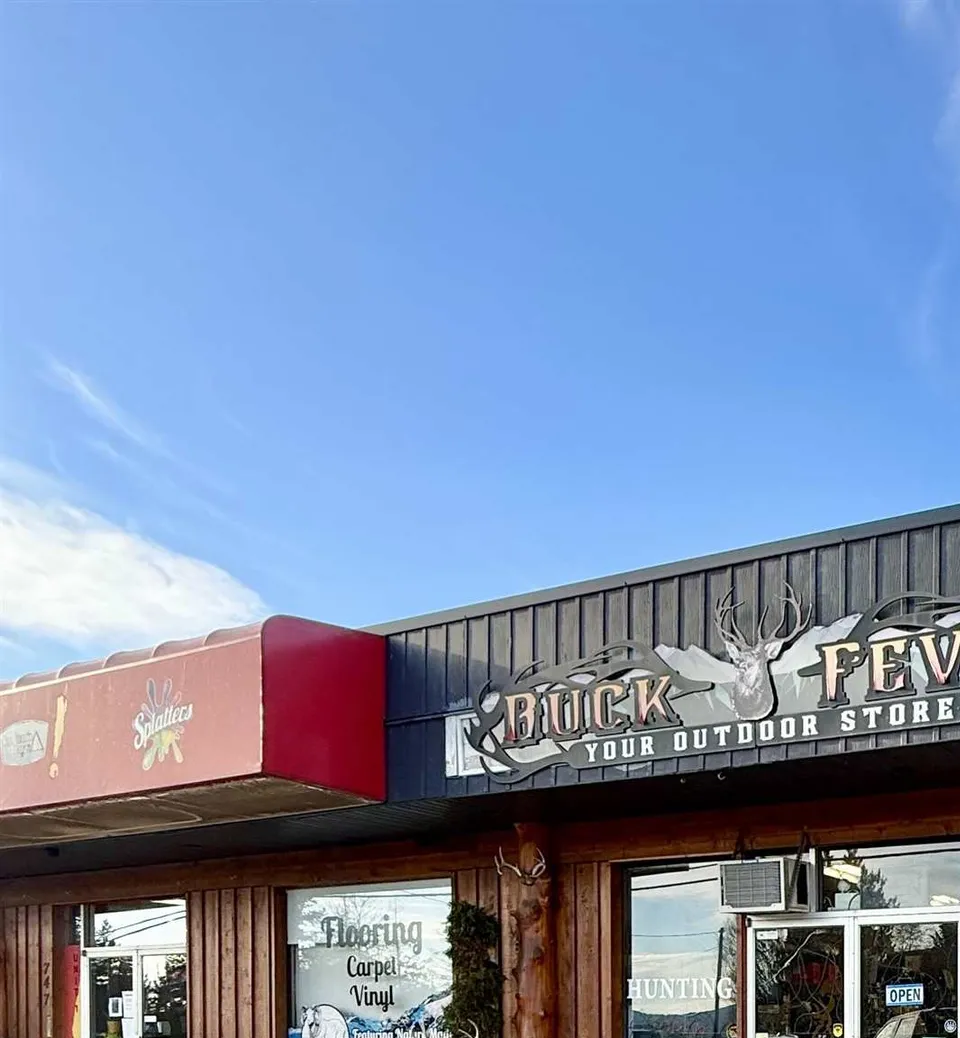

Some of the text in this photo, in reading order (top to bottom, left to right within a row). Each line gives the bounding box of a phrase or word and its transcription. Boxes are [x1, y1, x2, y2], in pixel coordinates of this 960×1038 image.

[133, 702, 193, 750] Splatters
[503, 674, 678, 746] BUCK
[585, 697, 955, 763] YOUR OUTDOOR STORE
[320, 914, 423, 955] Flooring
[346, 955, 397, 982] Carpet
[349, 984, 395, 1012] Vinyl
[626, 977, 733, 1000] HUNTING
[890, 987, 921, 1003] OPEN
